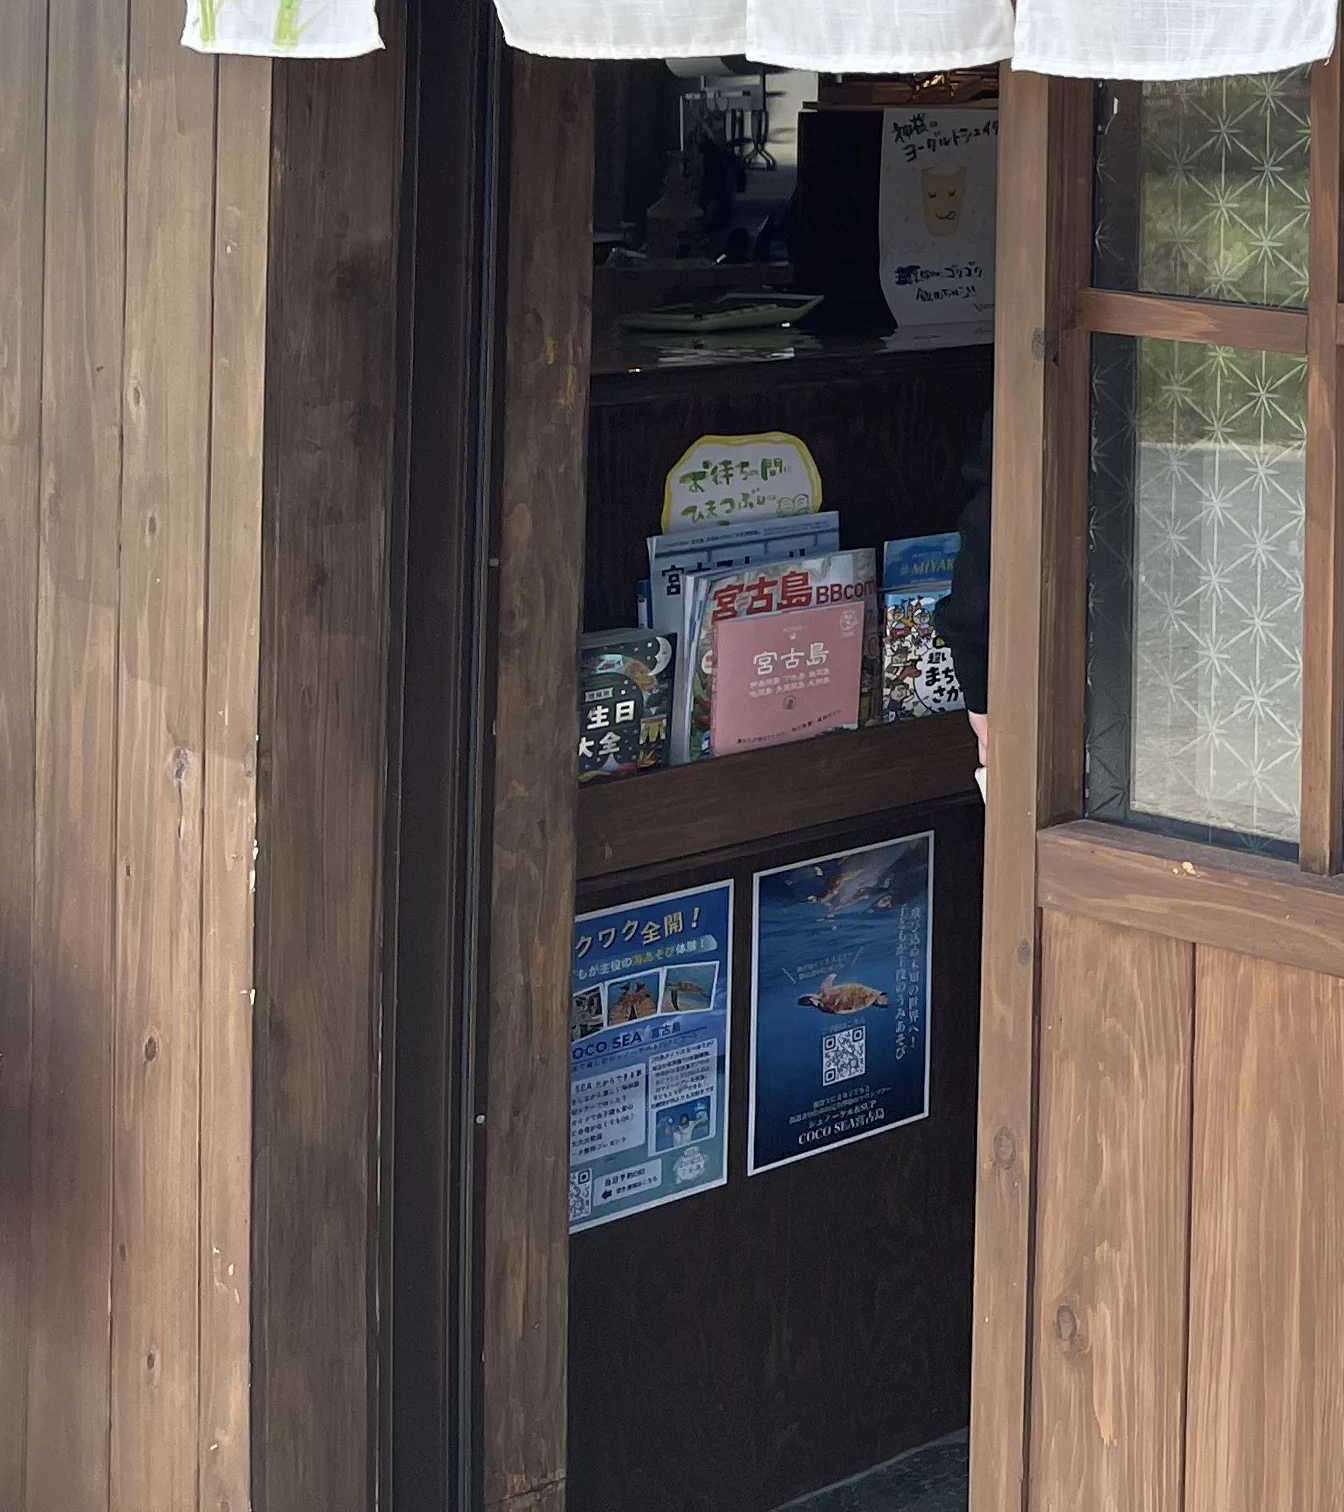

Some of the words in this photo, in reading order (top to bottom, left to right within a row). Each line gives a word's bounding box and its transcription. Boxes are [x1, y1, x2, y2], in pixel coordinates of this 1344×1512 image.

[753, 642, 830, 676] 宮古島
[612, 1031, 643, 1050] SEA
[798, 1126, 832, 1146] COCO
